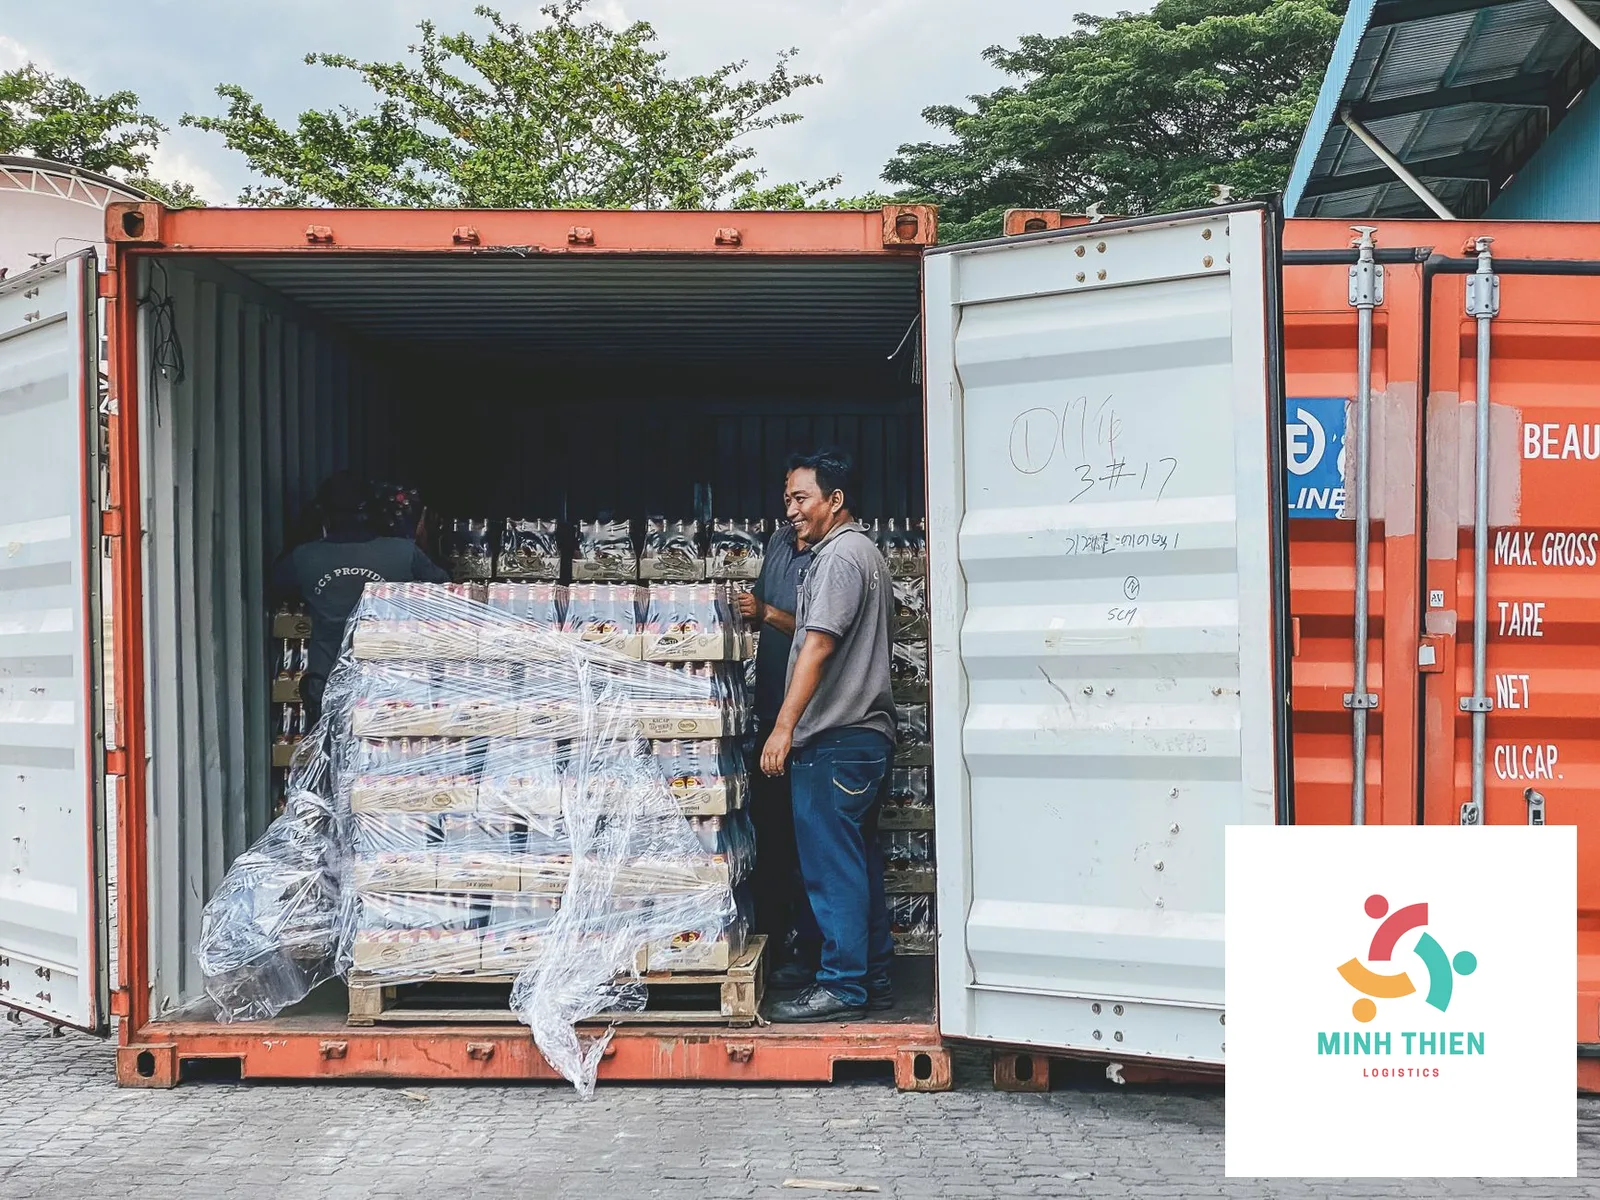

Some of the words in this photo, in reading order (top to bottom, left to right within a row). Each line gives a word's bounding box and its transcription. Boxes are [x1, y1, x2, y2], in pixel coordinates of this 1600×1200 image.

[1523, 422, 1600, 460] BEAU
[1288, 487, 1347, 510] INE
[1493, 531, 1538, 567] MAX.
[1541, 531, 1599, 567] GROSS
[1497, 601, 1546, 637] TARE
[1495, 674, 1530, 709] NET
[1493, 744, 1564, 780] CU.CAP.
